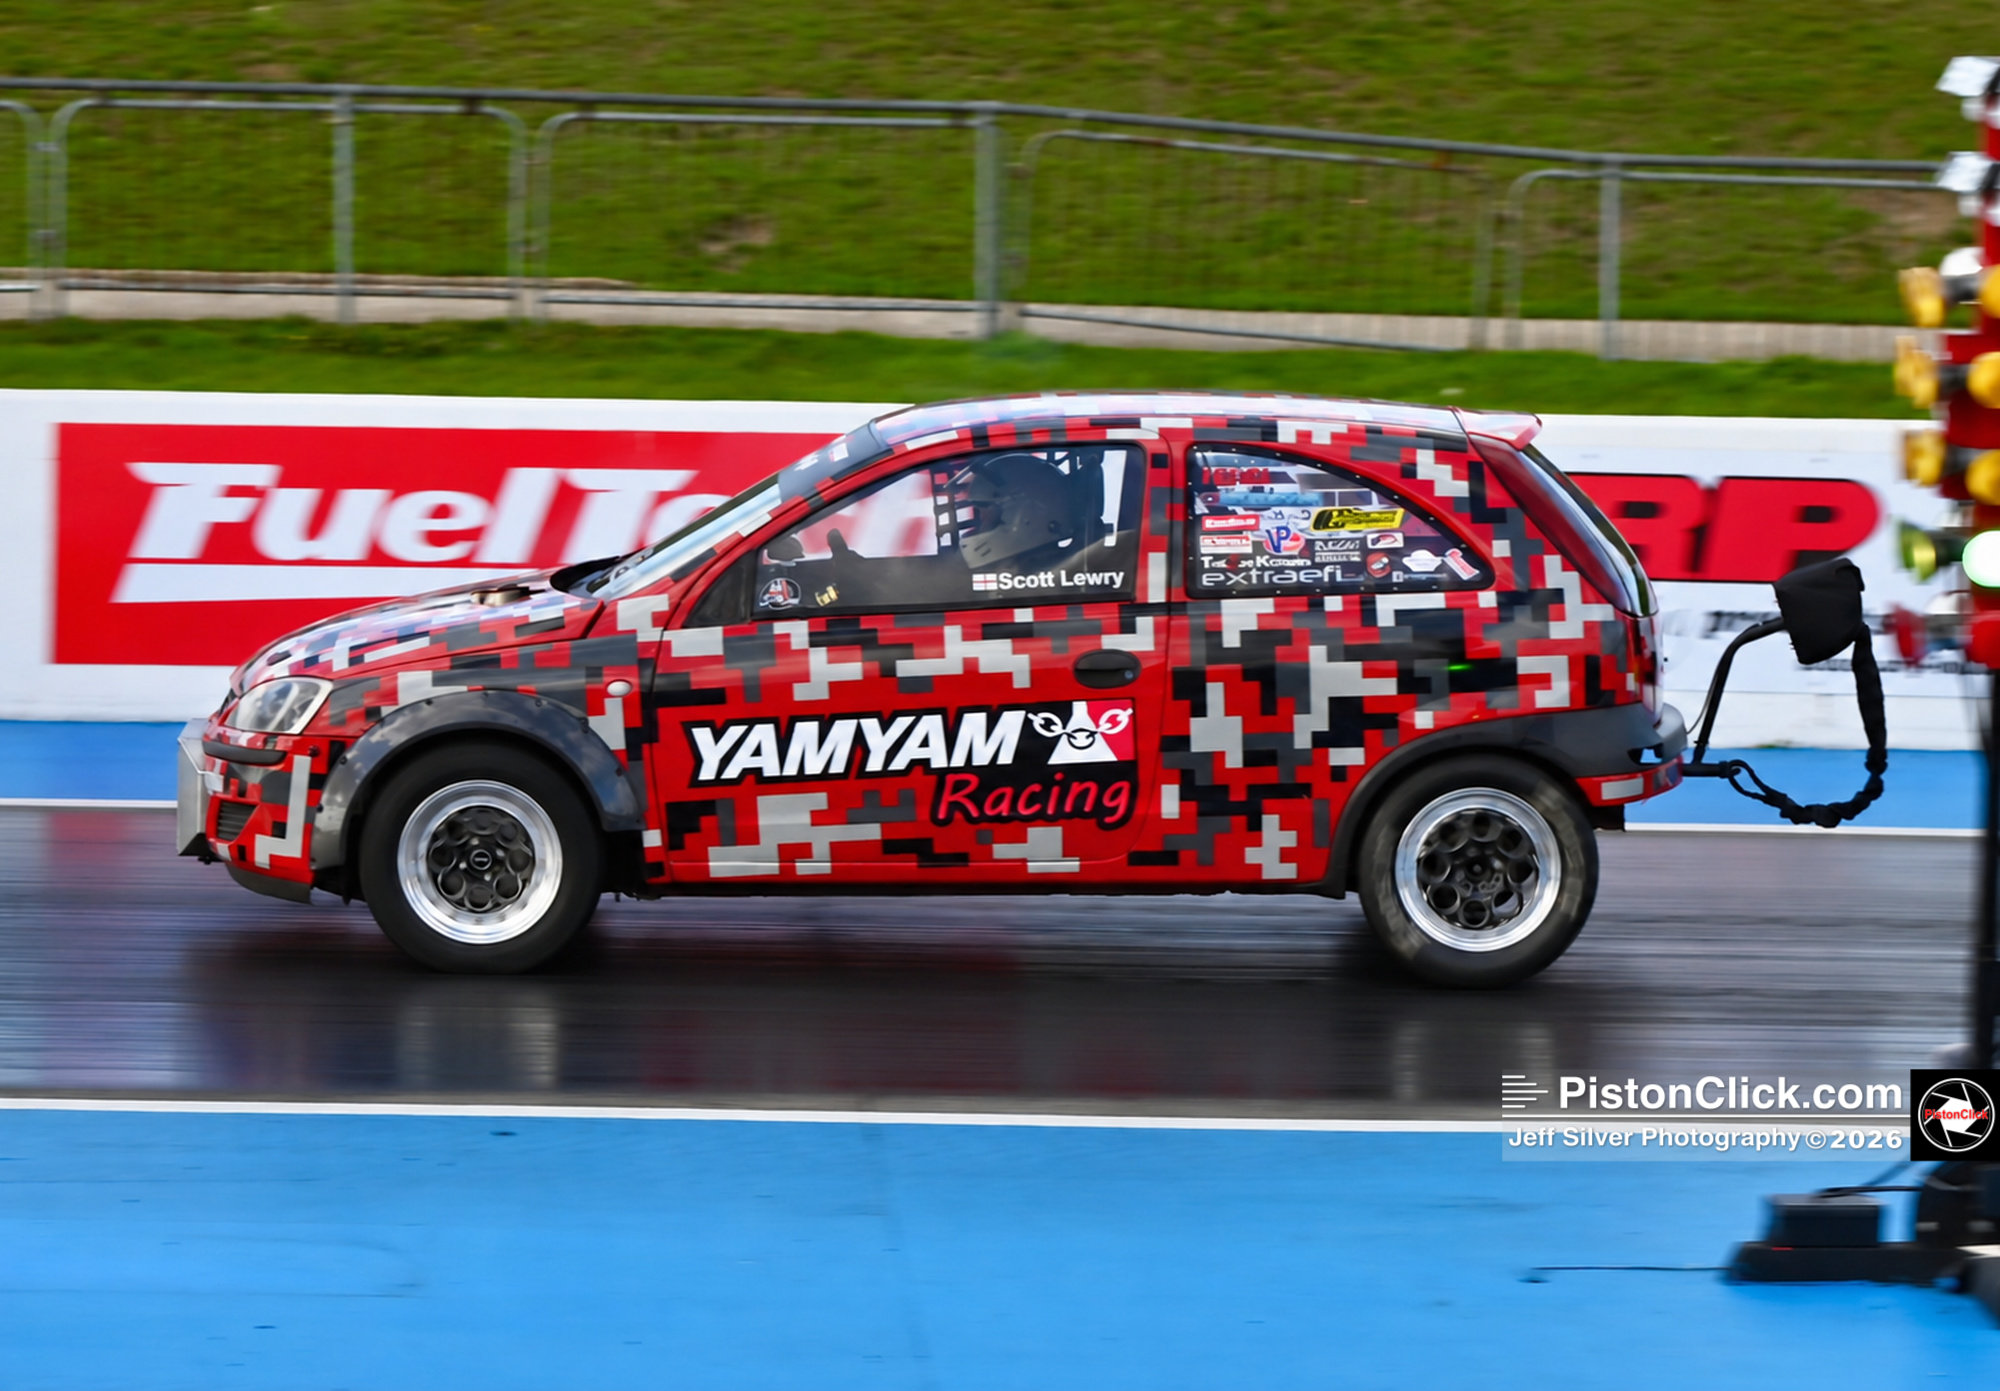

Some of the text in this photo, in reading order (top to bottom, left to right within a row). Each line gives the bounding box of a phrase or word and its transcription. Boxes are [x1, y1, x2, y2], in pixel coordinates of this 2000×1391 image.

[998, 570, 1124, 590] Scott Lewry
[691, 710, 1026, 780] YAMYAM
[937, 773, 1132, 823] Racing
